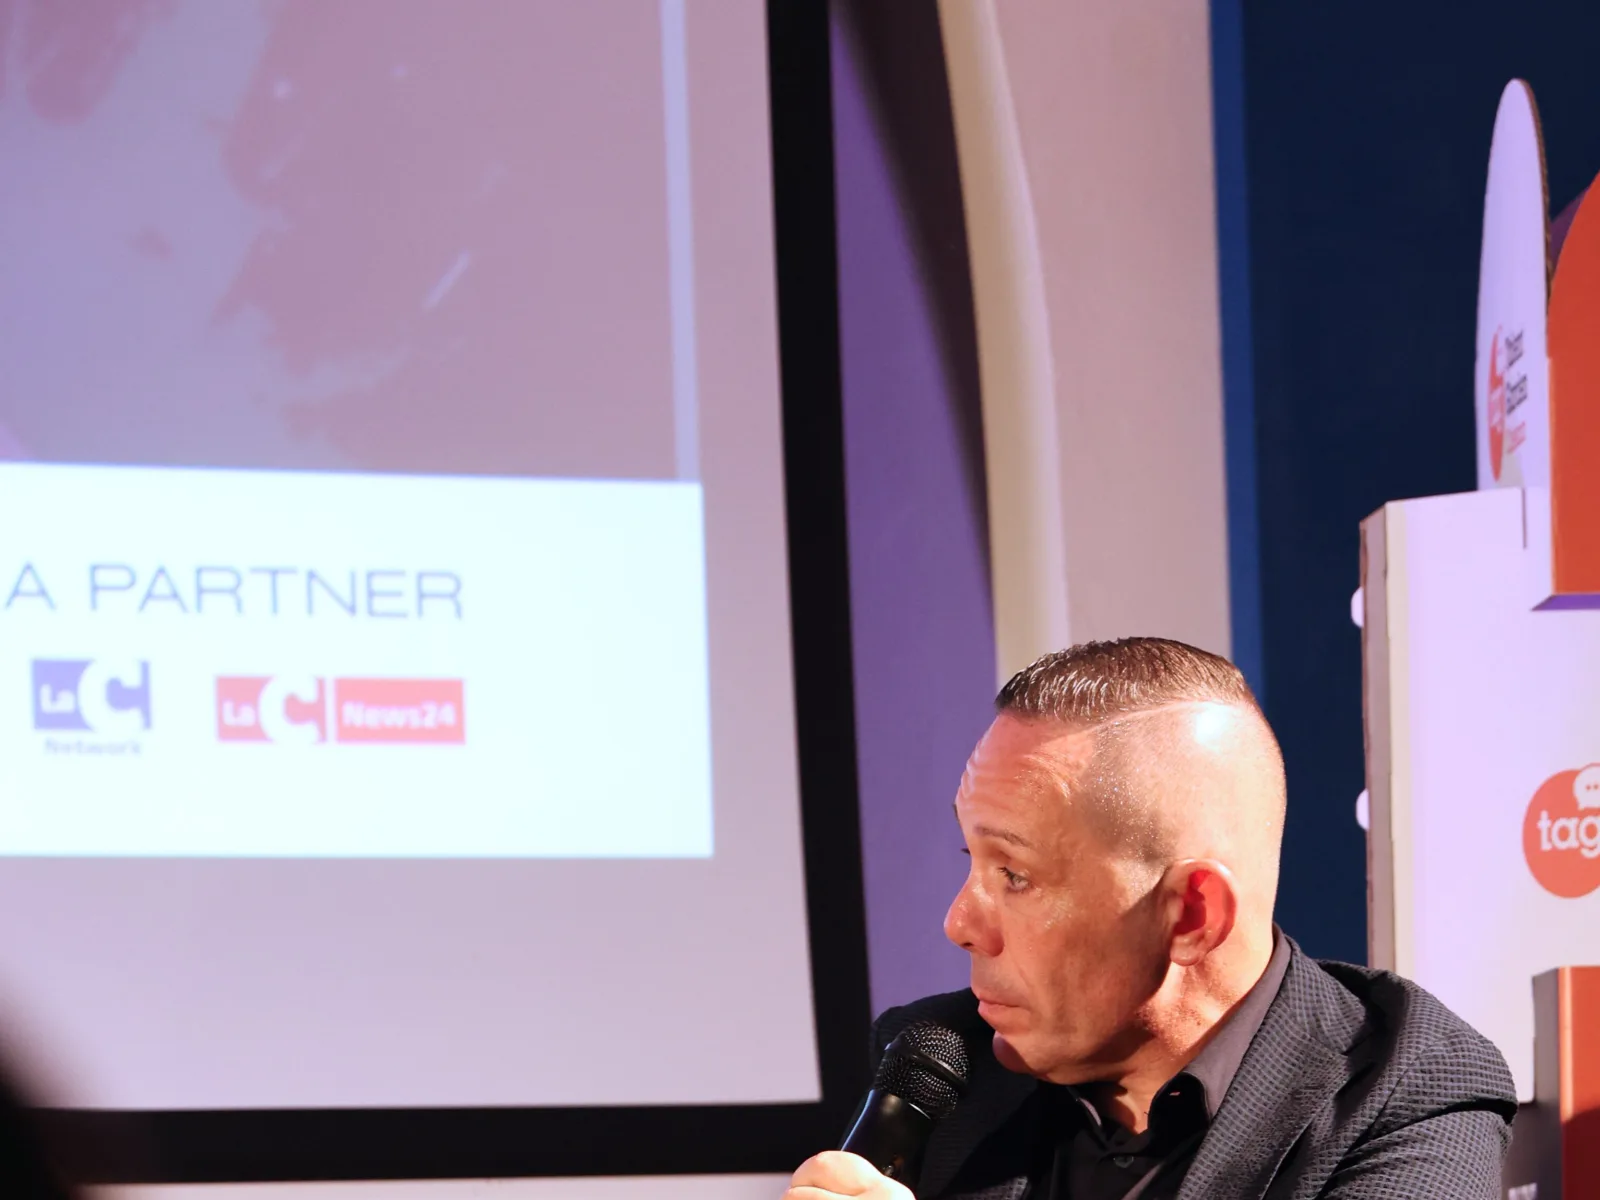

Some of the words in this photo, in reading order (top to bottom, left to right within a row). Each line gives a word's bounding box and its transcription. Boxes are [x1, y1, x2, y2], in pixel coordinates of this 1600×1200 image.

[89, 563, 464, 621] PARTNER
[342, 702, 457, 729] News24
[44, 738, 141, 756] Network
